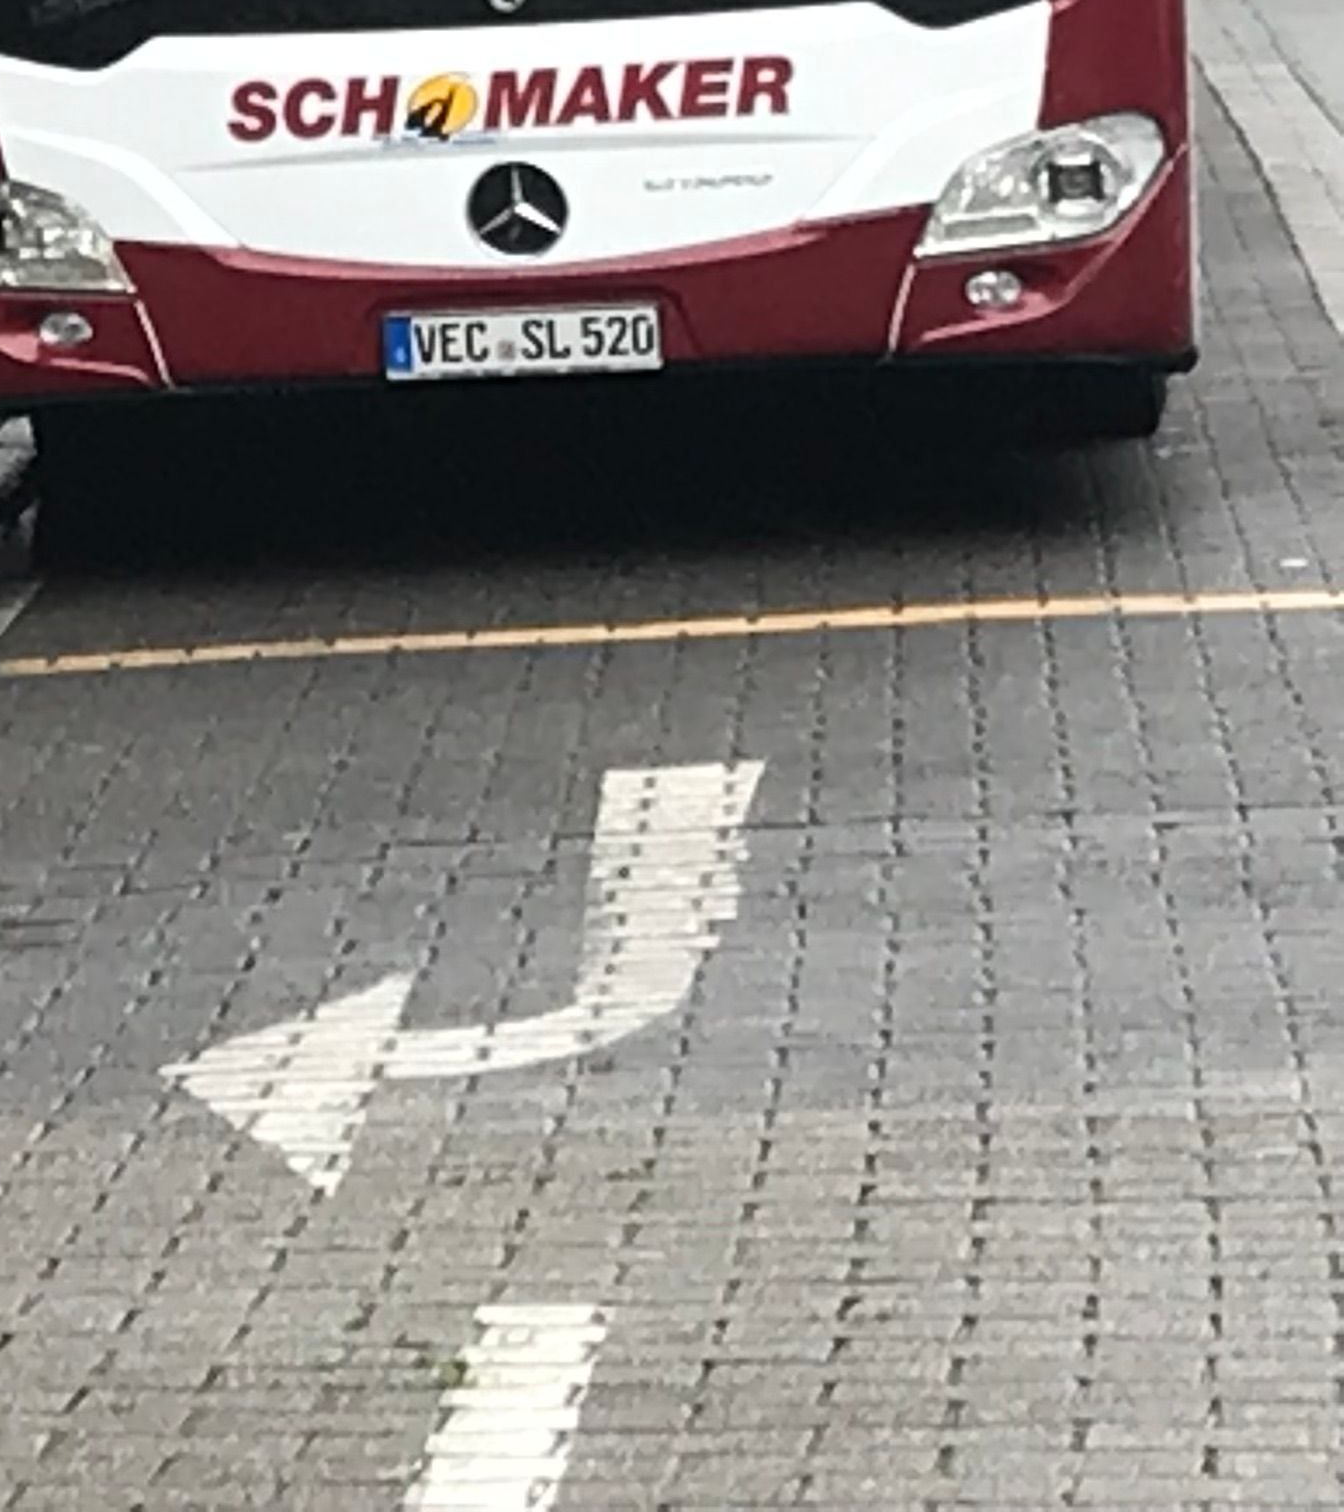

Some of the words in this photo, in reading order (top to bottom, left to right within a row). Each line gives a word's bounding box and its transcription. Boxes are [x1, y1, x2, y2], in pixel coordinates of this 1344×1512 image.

[413, 321, 489, 364] VEC
[520, 318, 572, 360] SL
[581, 315, 655, 357] 520
